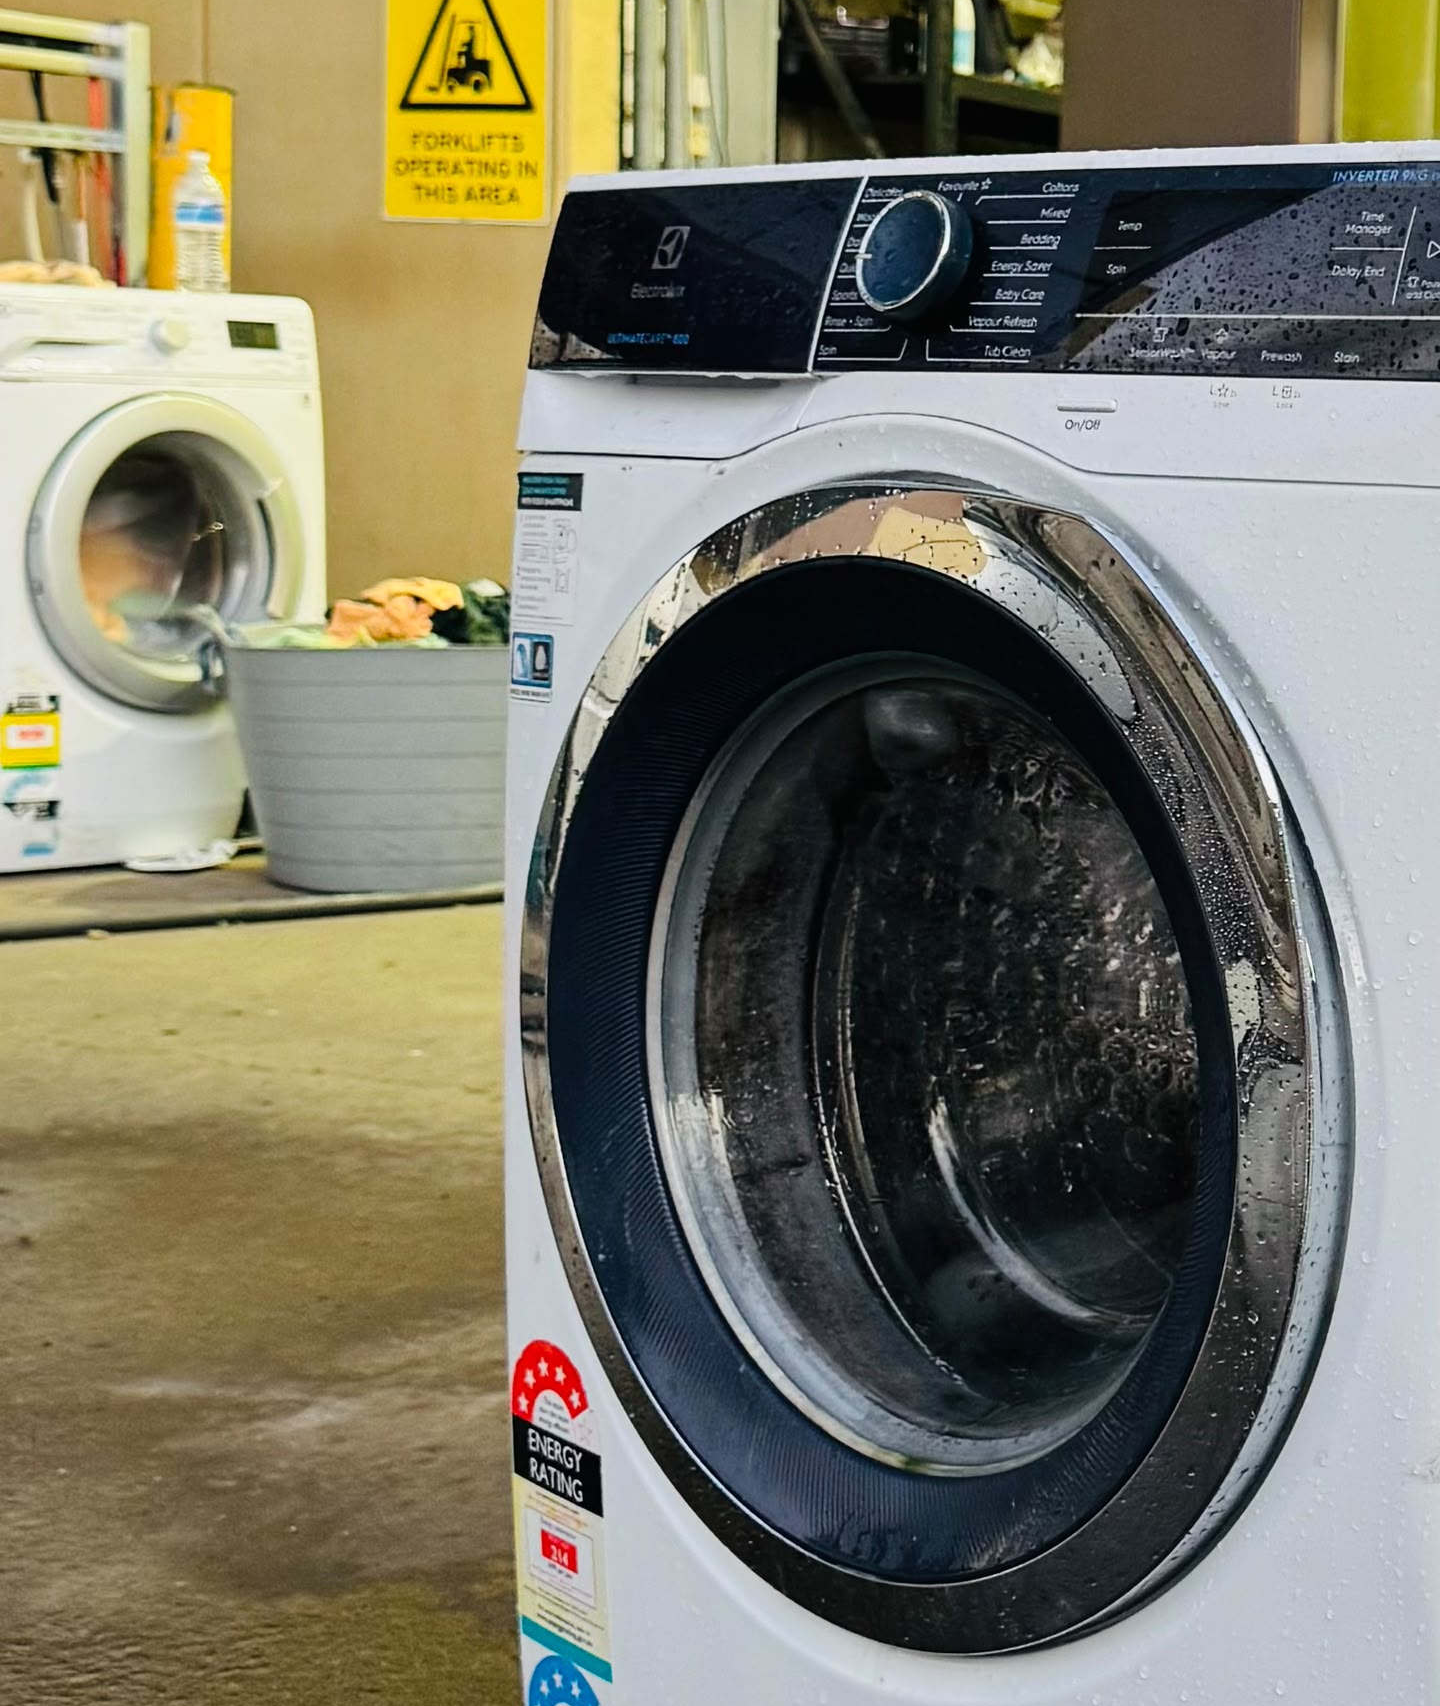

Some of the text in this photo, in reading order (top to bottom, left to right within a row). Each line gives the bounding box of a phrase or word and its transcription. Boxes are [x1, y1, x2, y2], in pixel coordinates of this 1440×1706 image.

[411, 133, 524, 153] FORKLIFTS
[395, 158, 538, 178] OPERATING IN
[1333, 170, 1399, 182] INVERTER
[1402, 169, 1428, 181] 9KG
[938, 181, 979, 192] Favourite
[1043, 182, 1079, 193] Cottons
[413, 183, 520, 205] THIS AREA
[1040, 207, 1071, 219] Mixed
[1361, 212, 1384, 222] Time
[1118, 220, 1142, 232] Temp
[1345, 224, 1392, 236] Manager
[1021, 234, 1061, 247] Bedding
[991, 261, 1052, 273] Energy Saver
[1106, 263, 1127, 275] Spin
[1332, 266, 1385, 279] Delay End
[631, 281, 686, 299] Electrolux
[995, 289, 1045, 302] Baby Care
[968, 315, 1037, 329] Vapour Refresh
[818, 344, 837, 356] Spin
[985, 345, 1031, 357] Tub Clean
[1261, 350, 1302, 362] Prewash
[1334, 352, 1360, 363] Stain
[1065, 419, 1101, 432] On/Off
[528, 1427, 583, 1473] ENERGY
[530, 1457, 583, 1502] RATING
